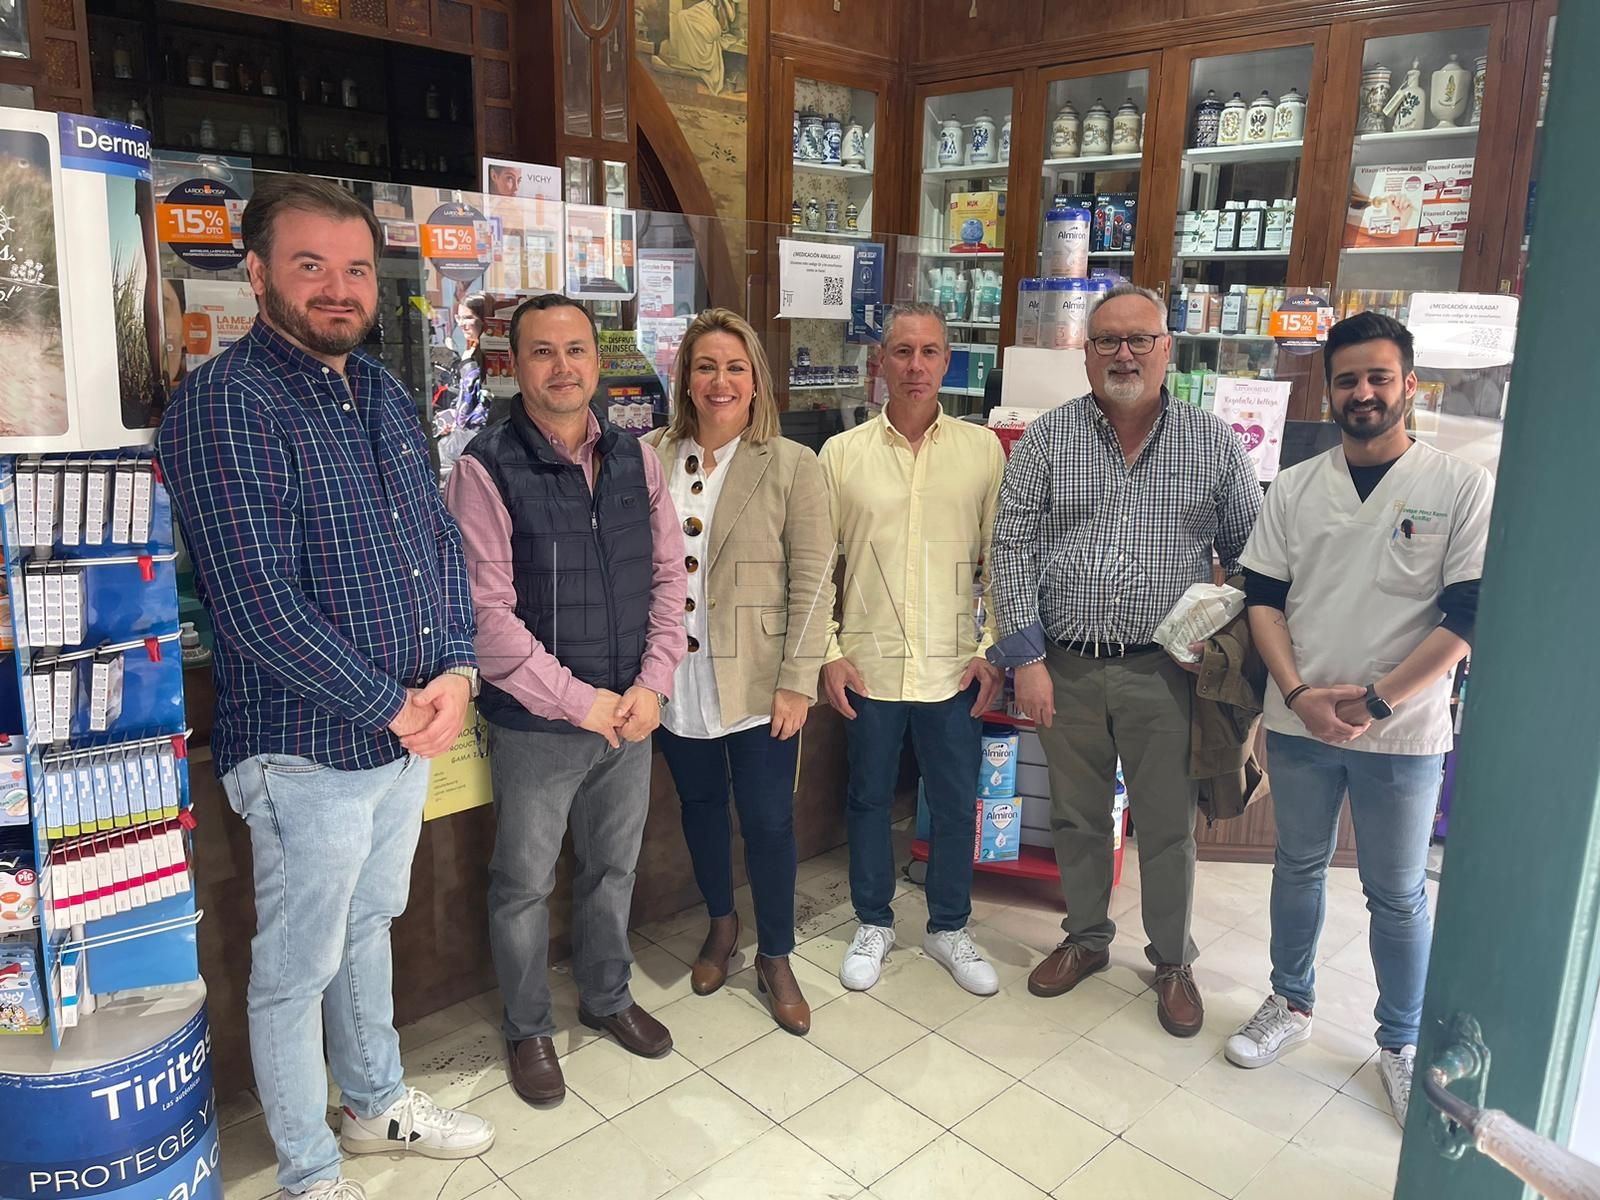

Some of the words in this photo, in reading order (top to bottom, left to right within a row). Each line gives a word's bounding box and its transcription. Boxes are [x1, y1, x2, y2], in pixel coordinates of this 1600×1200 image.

[527, 174, 552, 183] VICHY
[169, 208, 224, 234] -15%
[431, 228, 472, 250] -15%
[217, 315, 230, 324] LA
[1277, 314, 1314, 331] -15%
[982, 748, 1014, 758] Almirón
[986, 810, 1018, 821] Almirón
[91, 1024, 211, 1121] Tiritas
[29, 1119, 196, 1193] PROTEGE
